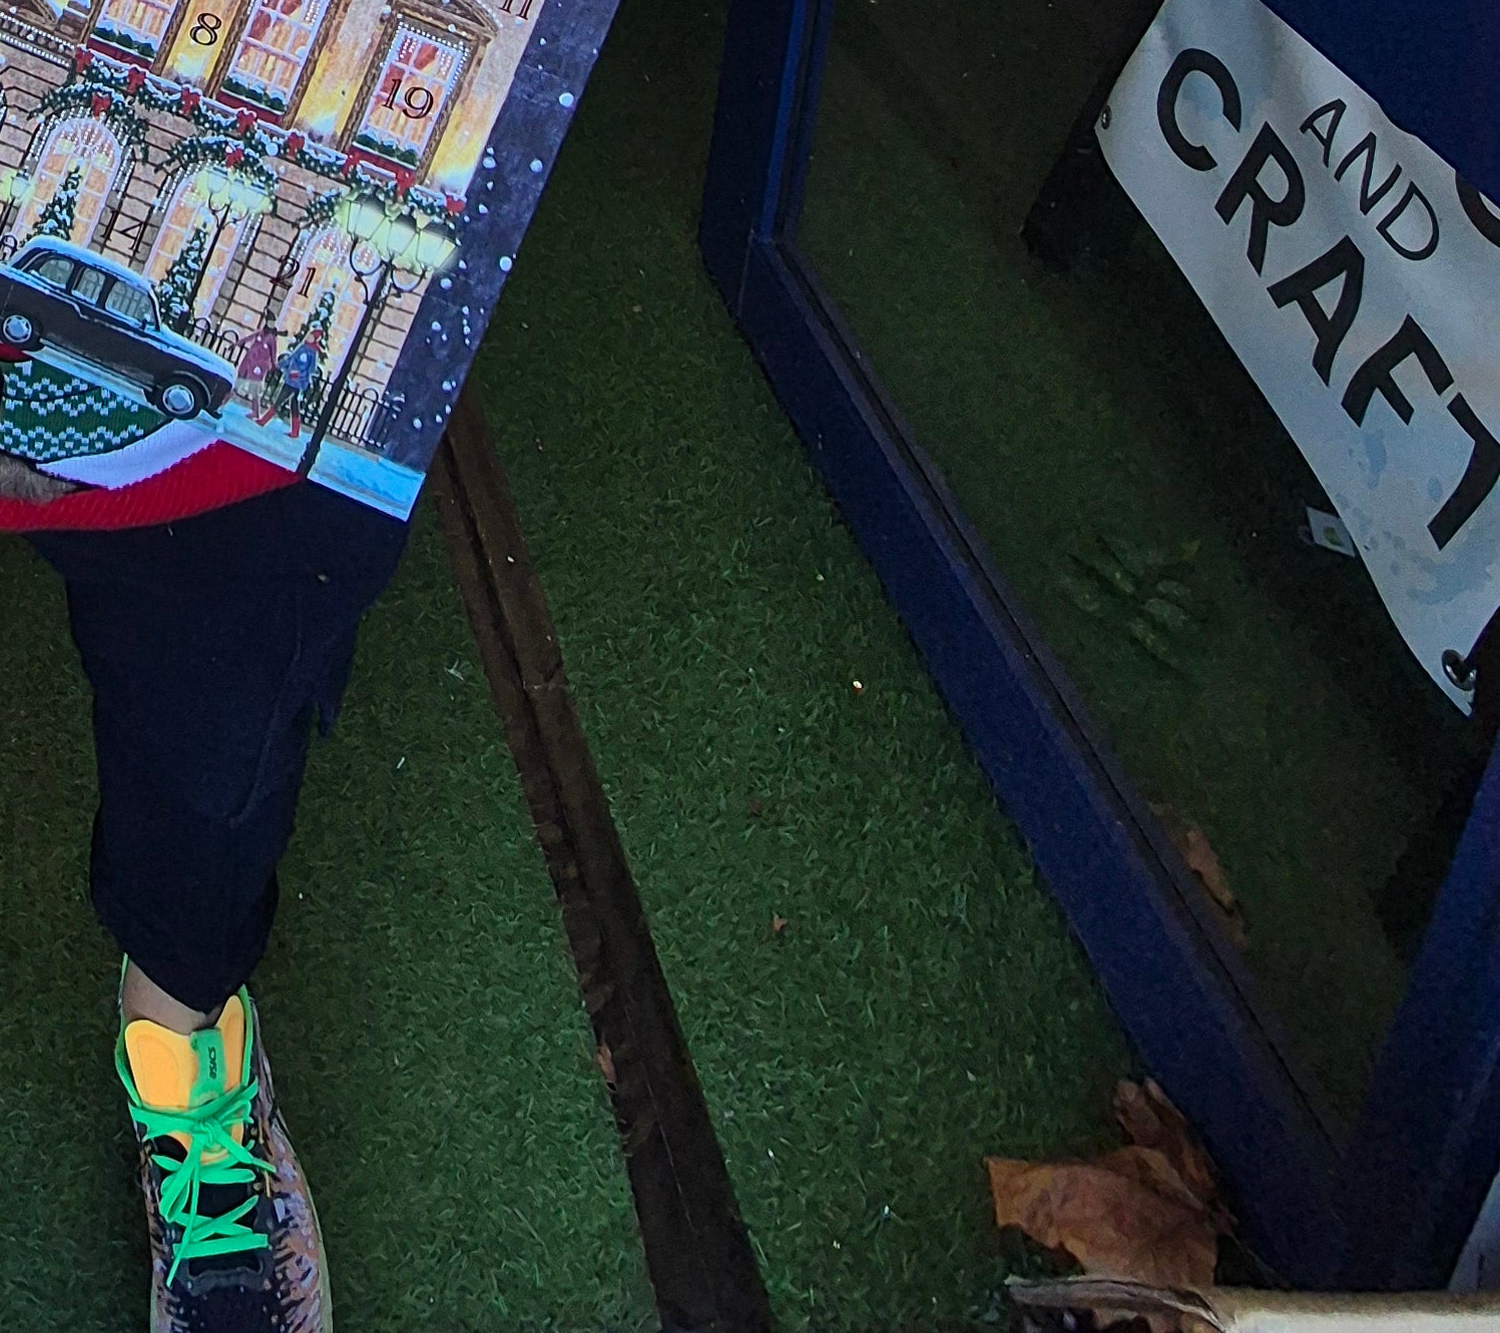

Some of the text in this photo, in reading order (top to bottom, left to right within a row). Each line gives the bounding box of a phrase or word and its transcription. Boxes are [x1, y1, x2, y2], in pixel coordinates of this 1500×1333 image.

[189, 12, 222, 48] 8
[382, 78, 434, 120] 19
[1299, 99, 1440, 262] AND
[99, 209, 147, 254] 14
[268, 254, 317, 299] 21
[1156, 48, 1500, 551] CRAFT
